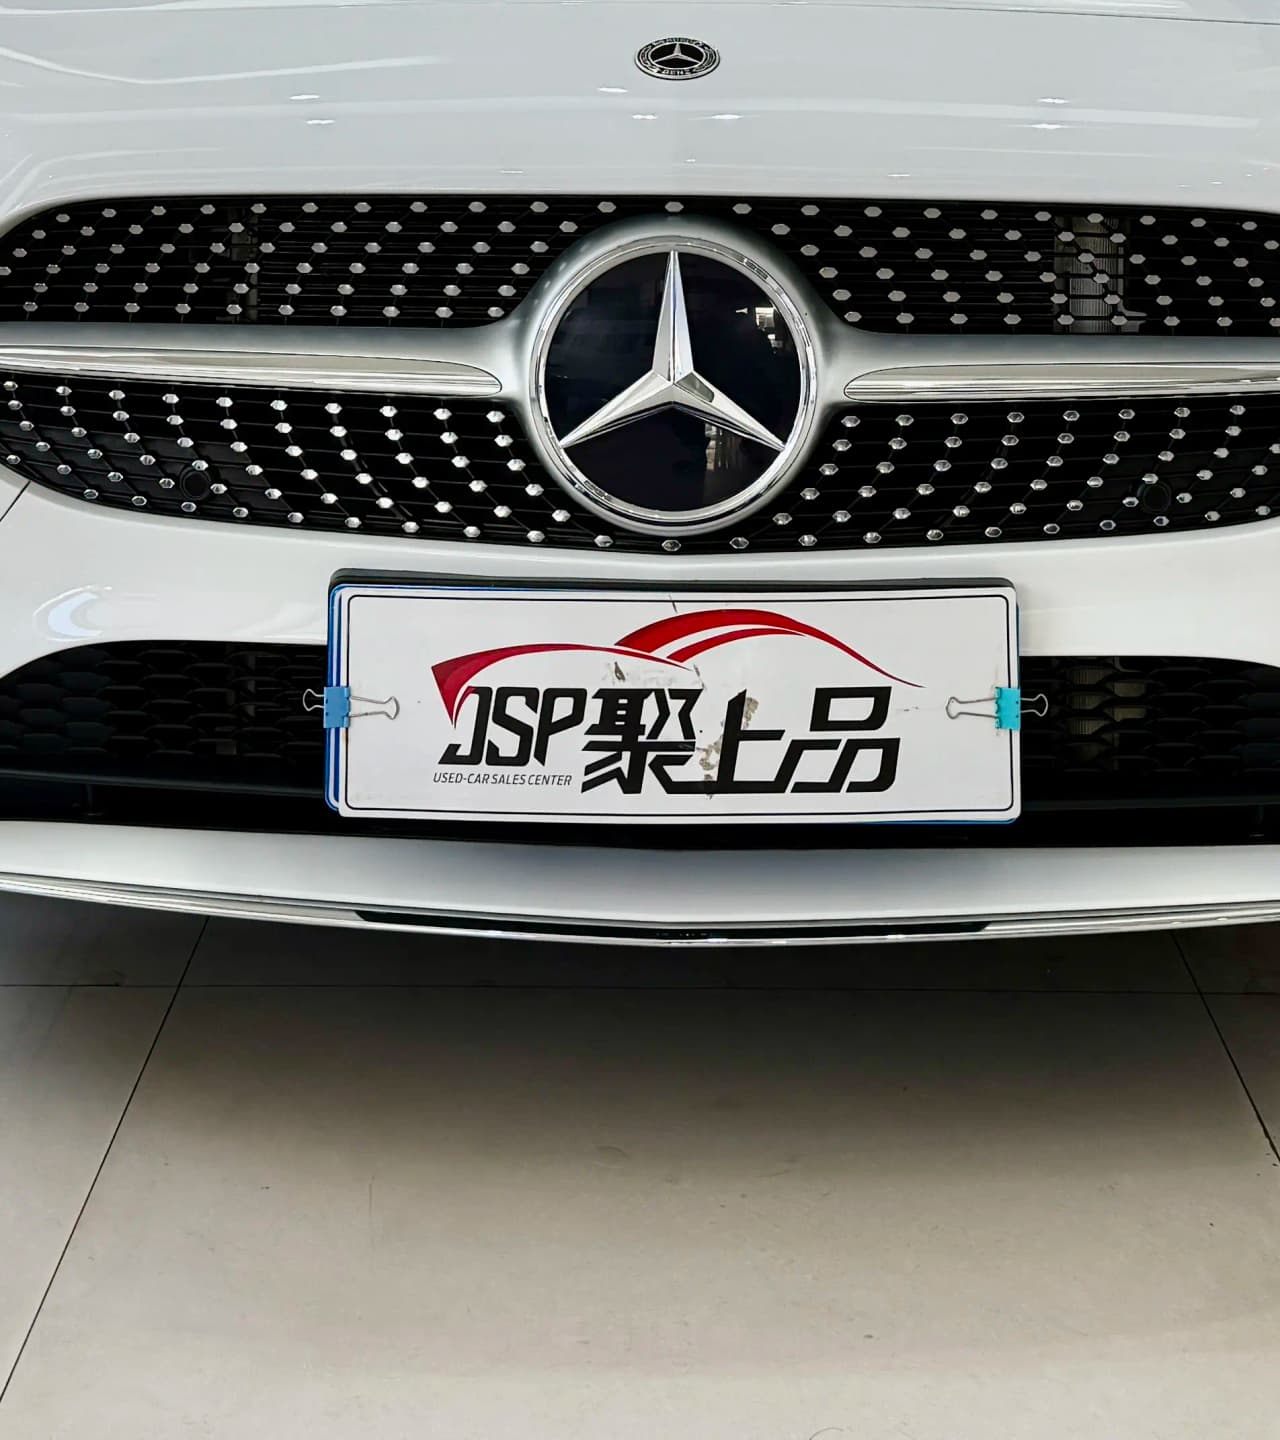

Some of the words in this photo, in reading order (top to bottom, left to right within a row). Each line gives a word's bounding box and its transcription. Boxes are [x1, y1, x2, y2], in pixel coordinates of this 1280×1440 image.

[433, 772, 489, 785] USED-CAR
[492, 774, 526, 785] SALES
[527, 774, 572, 786] CENTER
